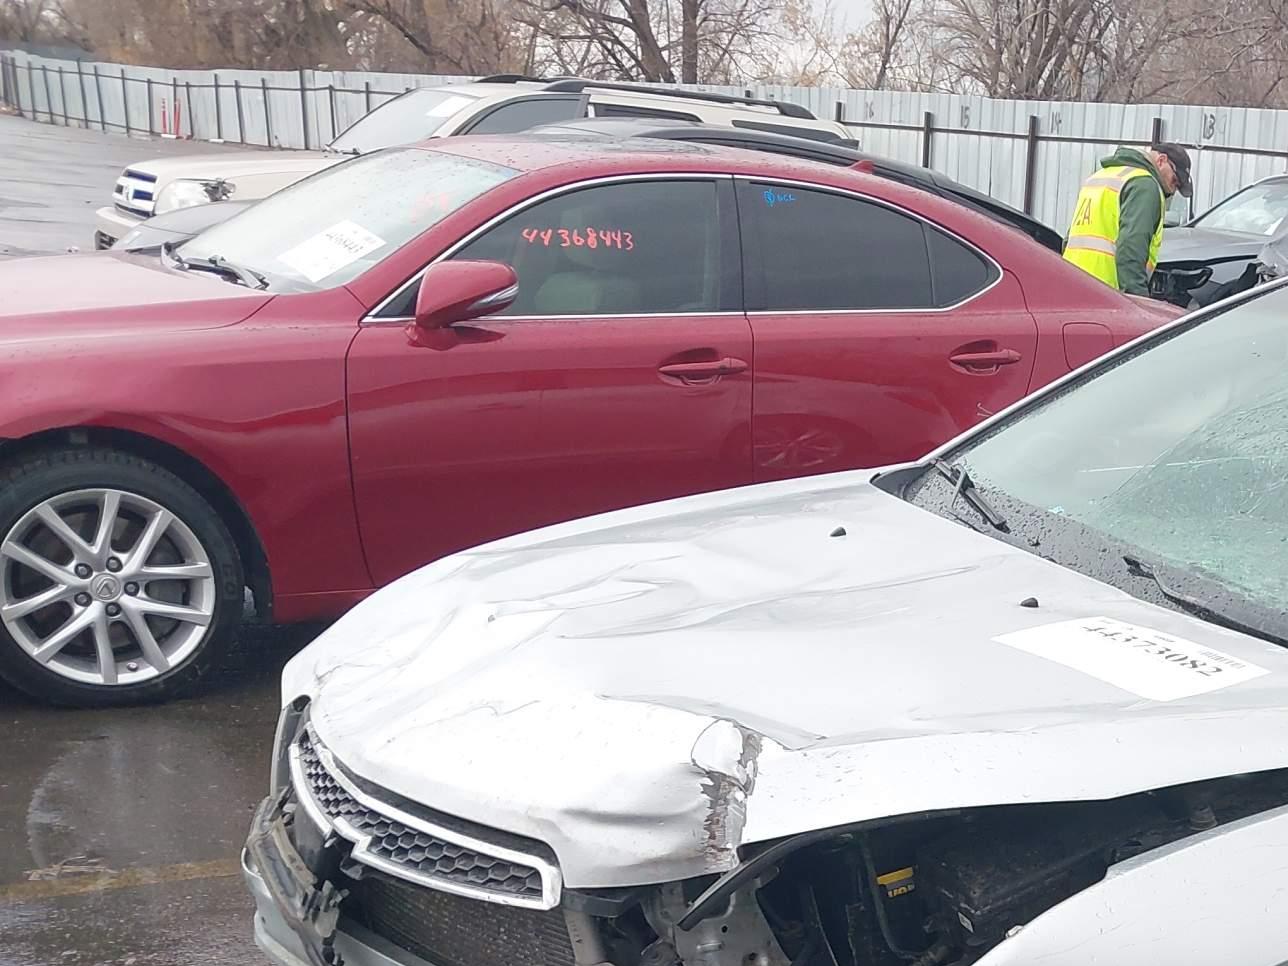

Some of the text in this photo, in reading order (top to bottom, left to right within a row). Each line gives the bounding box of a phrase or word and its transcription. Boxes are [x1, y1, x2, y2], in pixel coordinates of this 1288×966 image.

[960, 104, 971, 129] 15
[1051, 110, 1062, 135] 14
[1202, 112, 1216, 140] 13
[521, 226, 635, 251] 44368443
[1081, 625, 1224, 678] 44373082
